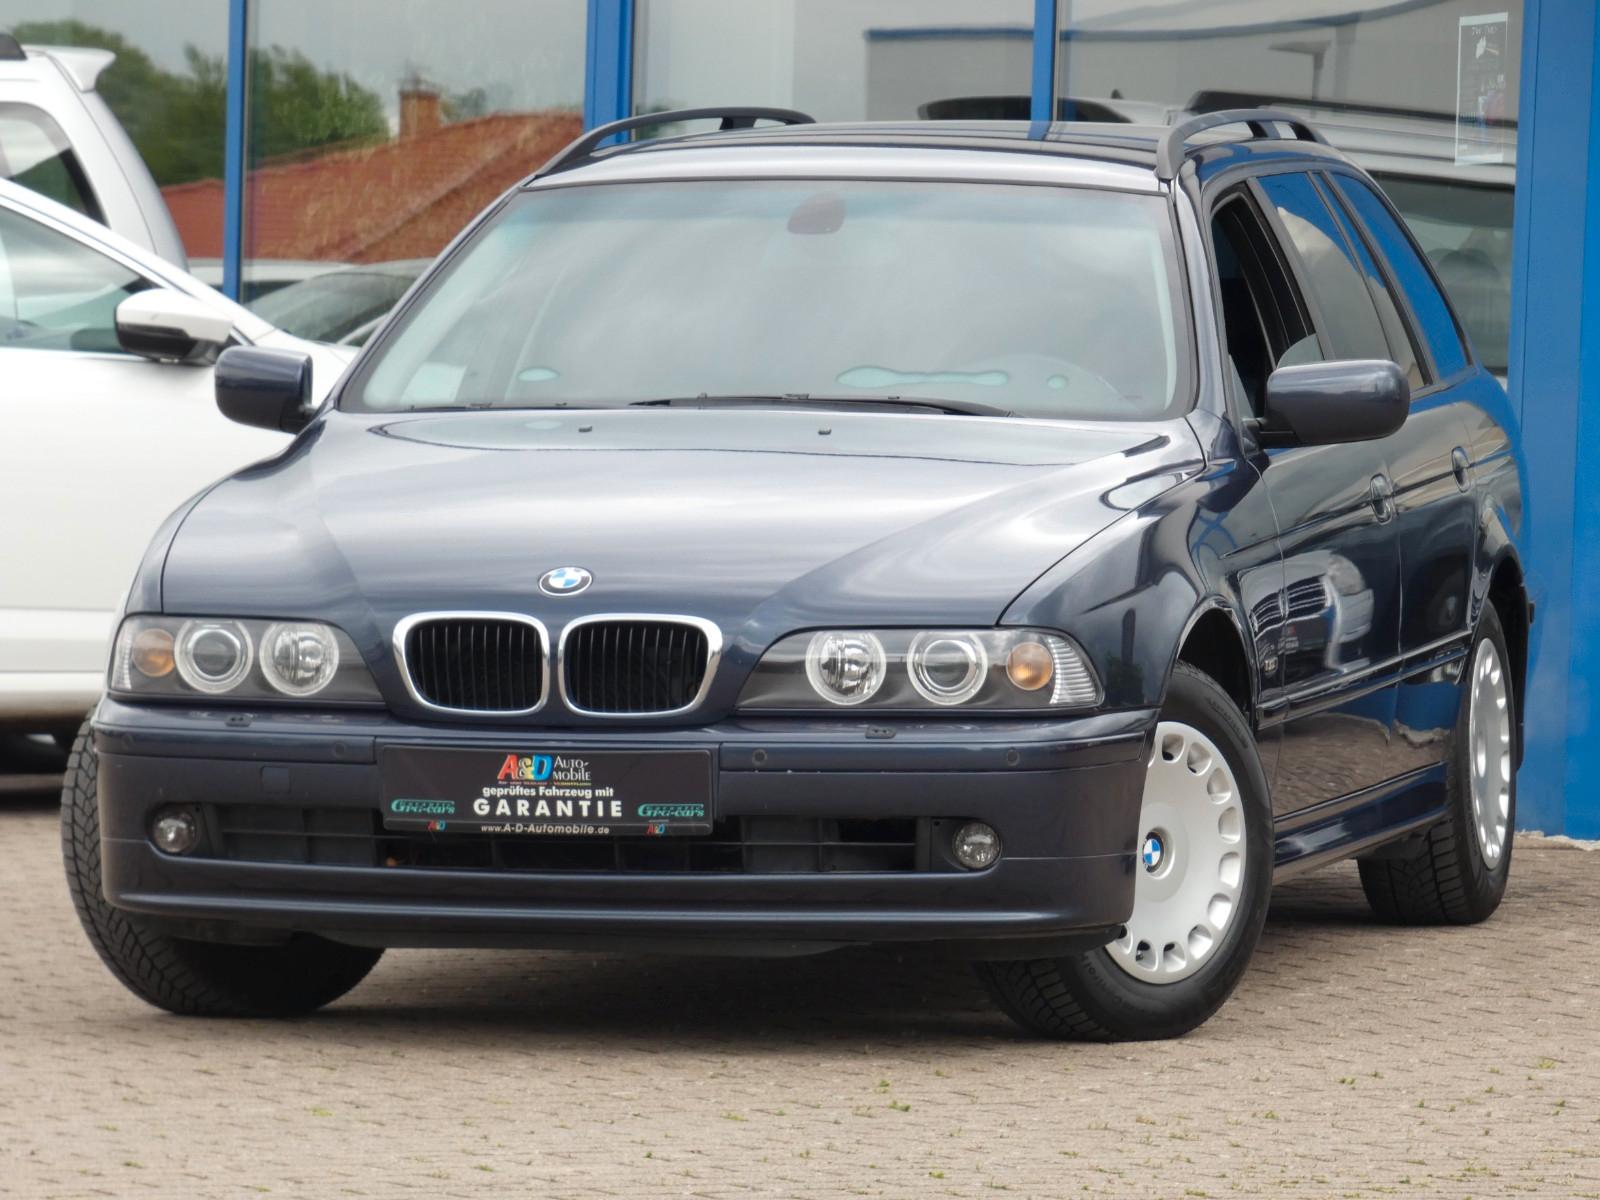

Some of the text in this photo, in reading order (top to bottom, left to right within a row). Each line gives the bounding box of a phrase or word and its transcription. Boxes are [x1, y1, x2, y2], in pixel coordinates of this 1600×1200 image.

[497, 754, 553, 780] A&D
[482, 786, 614, 799] geprüftes Fahrzeug mit
[473, 798, 622, 817] GARANTIE
[480, 823, 610, 834] www.A-D-Automobile.de
